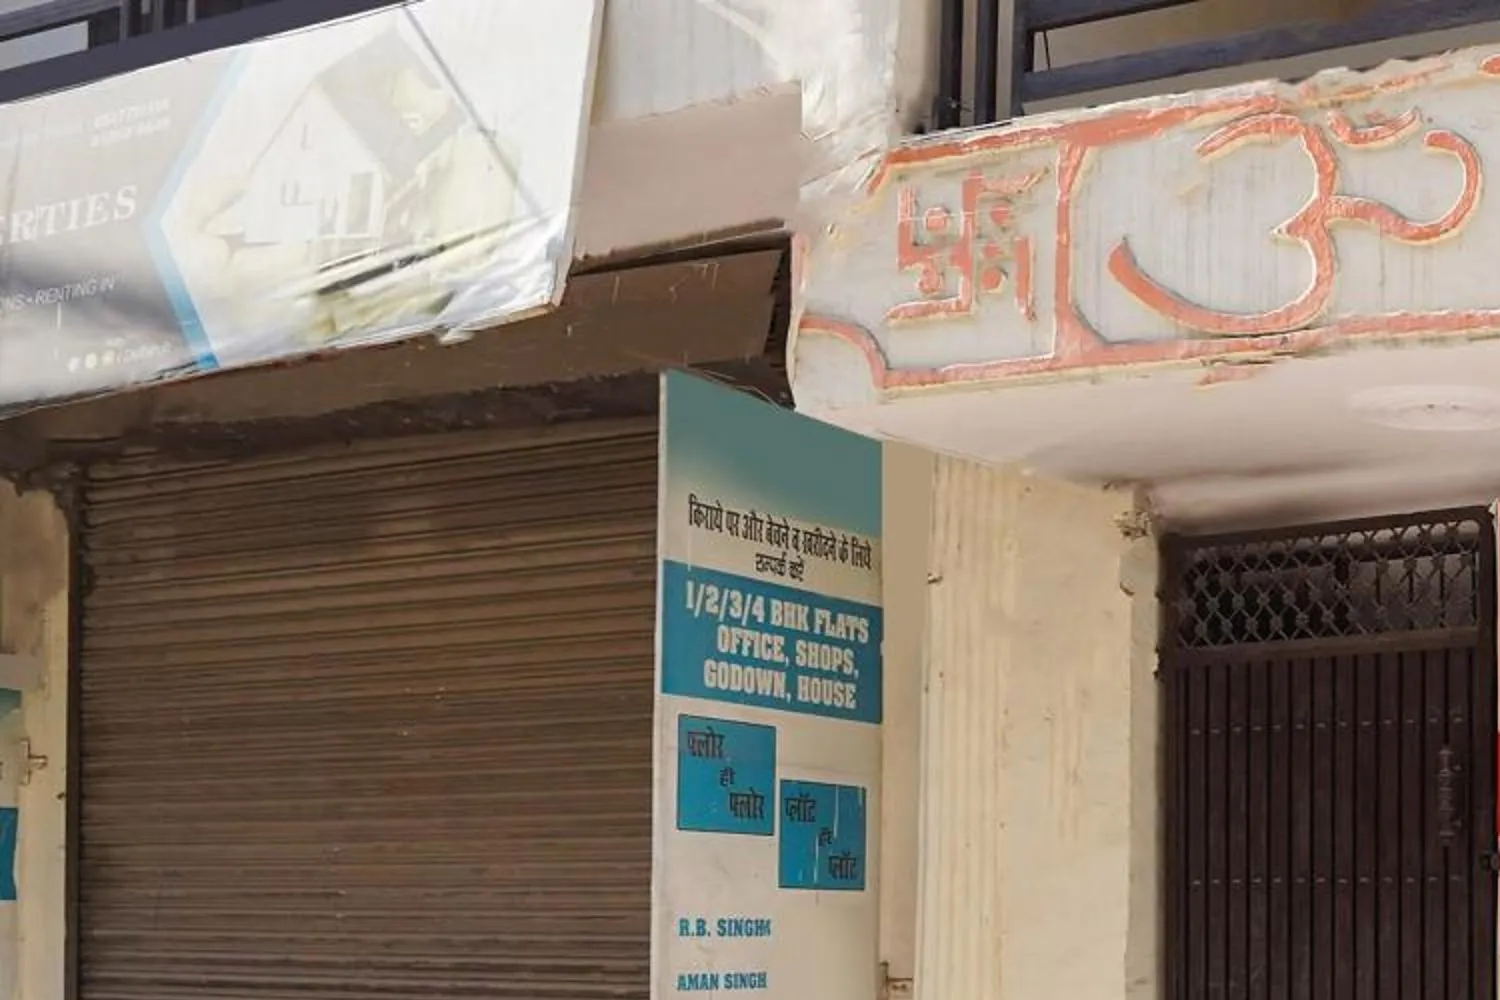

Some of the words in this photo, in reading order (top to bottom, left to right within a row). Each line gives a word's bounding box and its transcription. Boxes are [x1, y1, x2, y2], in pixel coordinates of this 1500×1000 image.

[0, 185, 138, 245] RTIES
[685, 581, 765, 626] 1/2/3/4
[770, 598, 809, 632] BHK
[814, 607, 869, 644] FLATS
[717, 624, 789, 666] OFFICE,
[796, 639, 859, 680] SHOPS,
[704, 658, 791, 702] GODOWN,
[797, 675, 857, 709] HOUSE
[679, 918, 711, 937] R.B.
[677, 972, 719, 991] AMAN
[724, 971, 767, 989] SINGH
